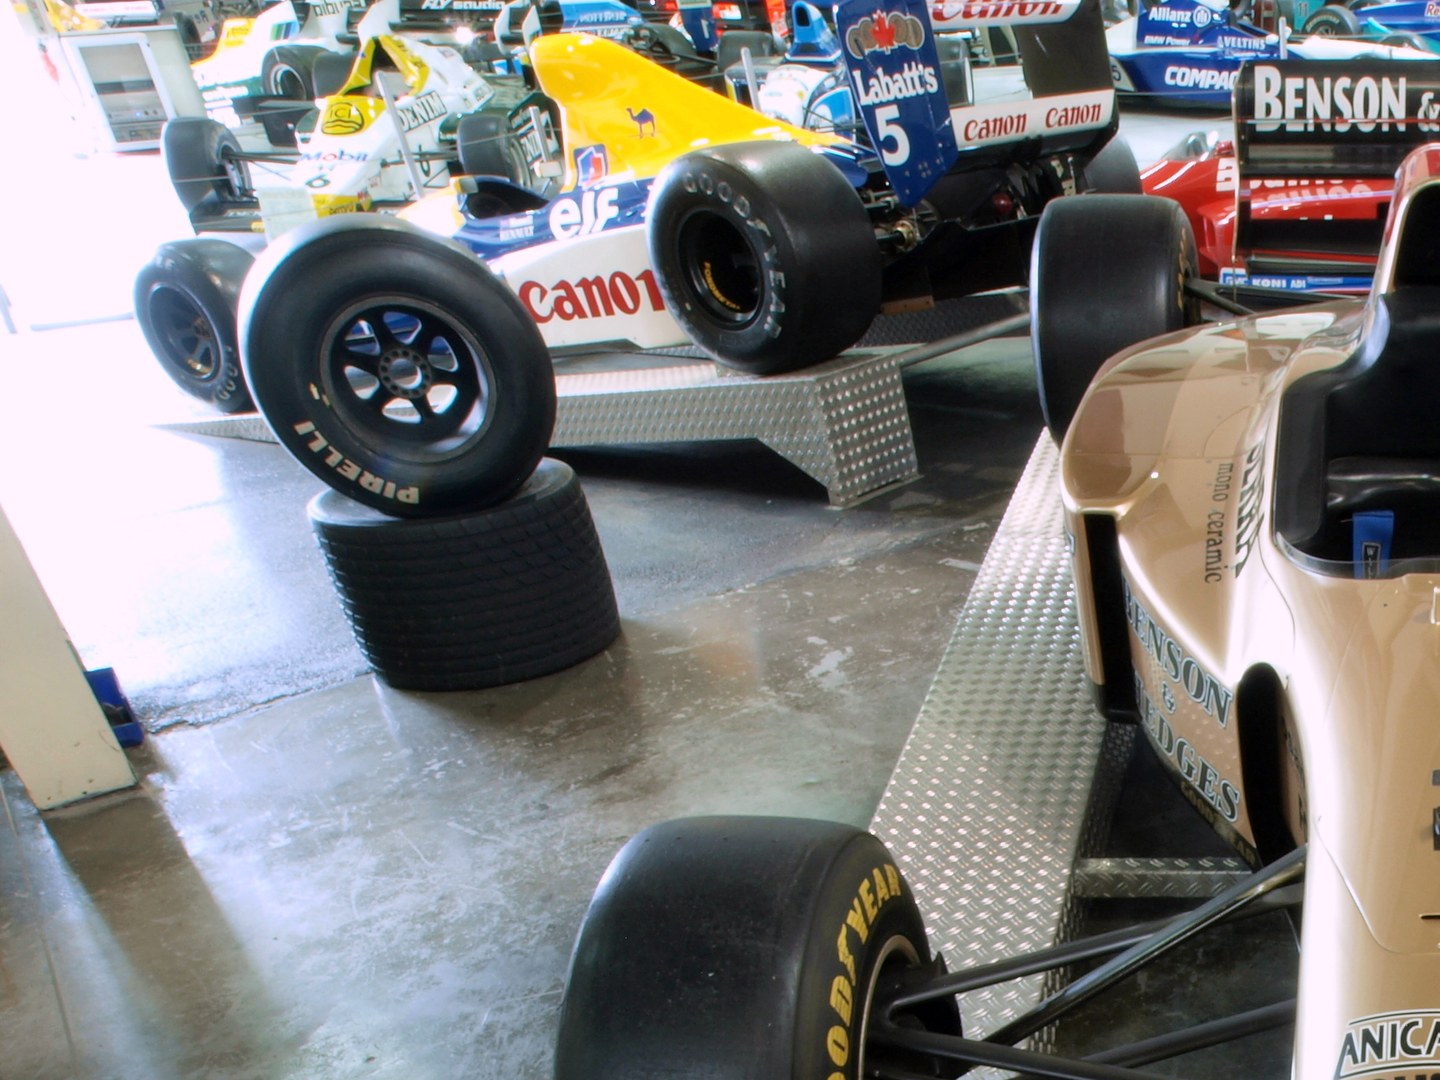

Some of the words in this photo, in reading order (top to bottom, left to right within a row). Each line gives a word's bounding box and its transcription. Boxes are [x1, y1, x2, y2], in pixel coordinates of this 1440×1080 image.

[1149, 6, 1193, 23] Allianz
[851, 62, 939, 107] Labatt's
[1253, 65, 1407, 133] BENSON
[1417, 91, 1440, 132] &
[875, 103, 911, 167] 5
[964, 112, 1028, 143] Canon
[1045, 102, 1102, 130] Canon
[549, 187, 619, 240] elf
[294, 420, 421, 504] PIRELLI
[1212, 463, 1234, 503] mono
[1204, 511, 1229, 585] ceramic
[1124, 583, 1233, 729] BENSON
[1135, 670, 1240, 823] HEDGES
